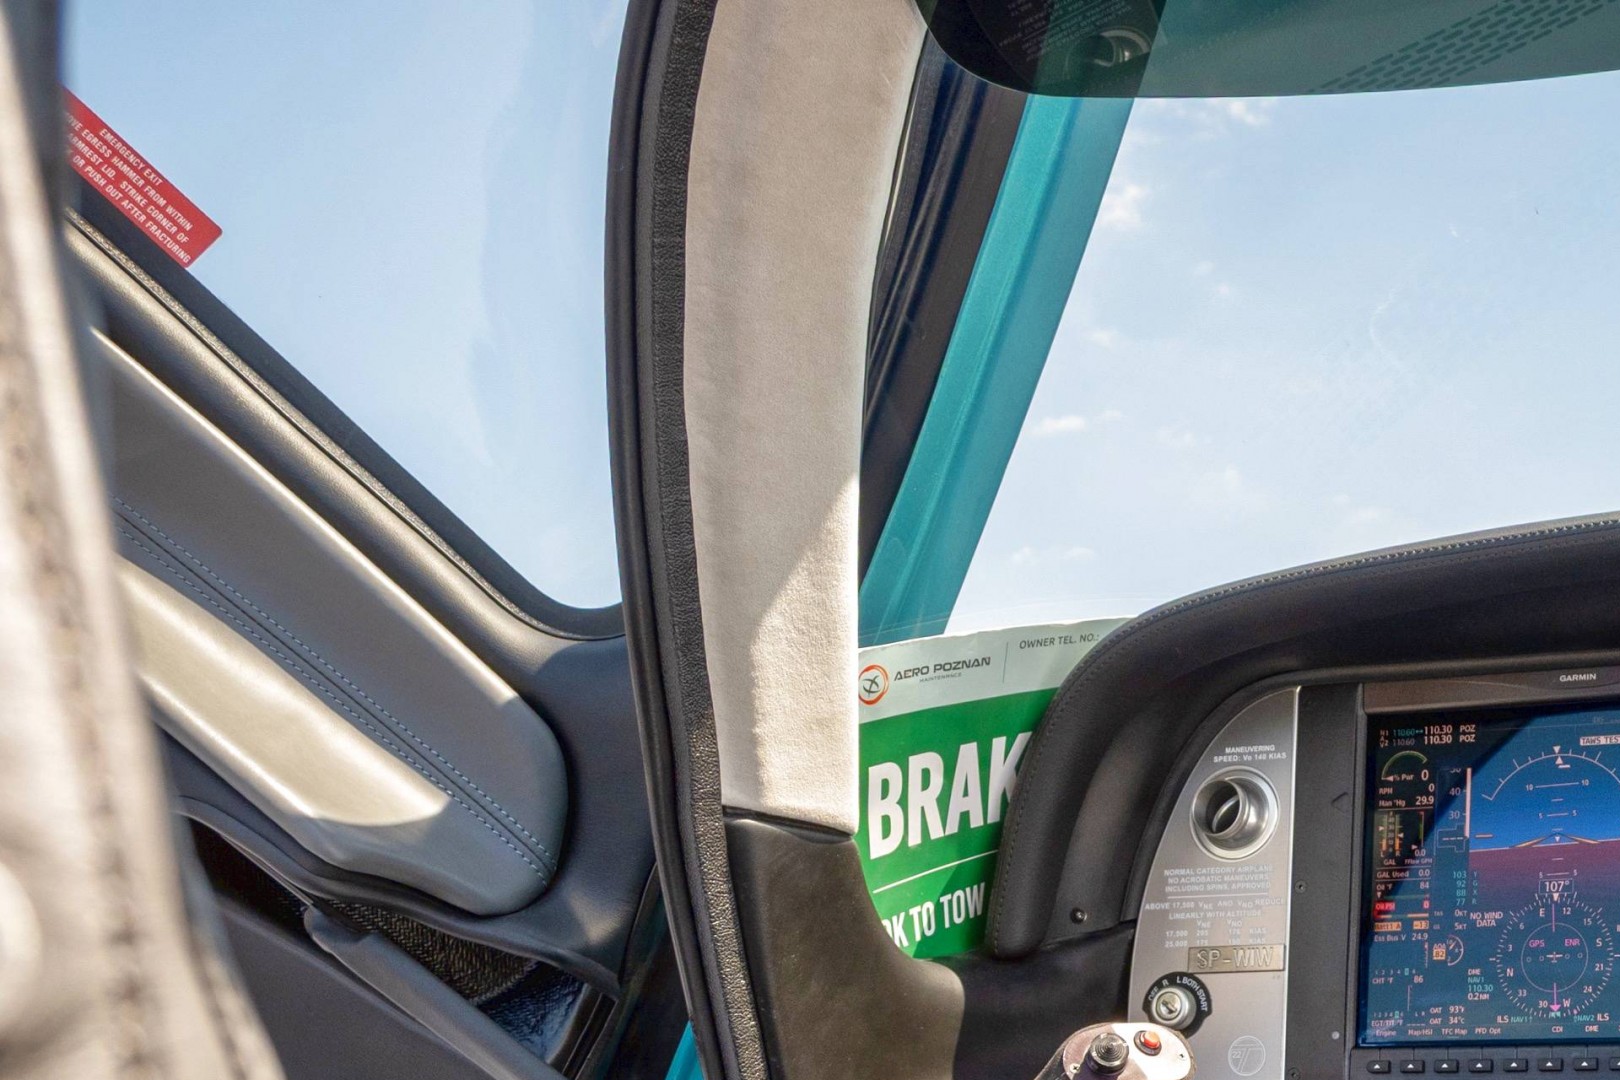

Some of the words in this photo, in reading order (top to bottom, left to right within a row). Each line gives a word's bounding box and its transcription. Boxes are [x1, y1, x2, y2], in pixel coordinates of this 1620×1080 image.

[99, 128, 145, 171] EMERGENCY
[143, 169, 164, 186] EXIT
[82, 129, 112, 158] EGRESS
[112, 156, 145, 186] HAMMER
[144, 185, 167, 208] FROM
[166, 204, 193, 231] WITHIN
[85, 166, 108, 186] PUSH
[106, 185, 123, 200] OUT
[122, 200, 147, 223] AFTER
[146, 221, 191, 263] FRACTURING
[120, 181, 149, 207] STRIKE
[147, 204, 178, 234] CORNER
[177, 232, 189, 244] OF
[1019, 636, 1055, 650] OWNER
[1058, 634, 1077, 645] TEL.
[894, 664, 930, 681] AERO
[933, 656, 991, 673] POZNAN
[1559, 673, 1597, 682] GARMIN
[1424, 725, 1453, 735] 110.30
[1459, 724, 1476, 733] POZ
[1424, 735, 1453, 744] 110.30
[1459, 735, 1476, 743] POZ
[1582, 737, 1604, 745] TAWS
[1225, 745, 1275, 754] MANEUVERING
[1213, 755, 1241, 763] SPEED:
[1164, 868, 1195, 876] NORMAL
[1196, 867, 1236, 875] CATEGORY
[1544, 880, 1569, 892] 107°
[909, 901, 936, 942] TO
[939, 881, 986, 929] TOW
[1485, 911, 1503, 919] WIND
[1476, 919, 1496, 927] DATA
[1182, 976, 1200, 993] BOTH
[1197, 990, 1208, 1012] START
